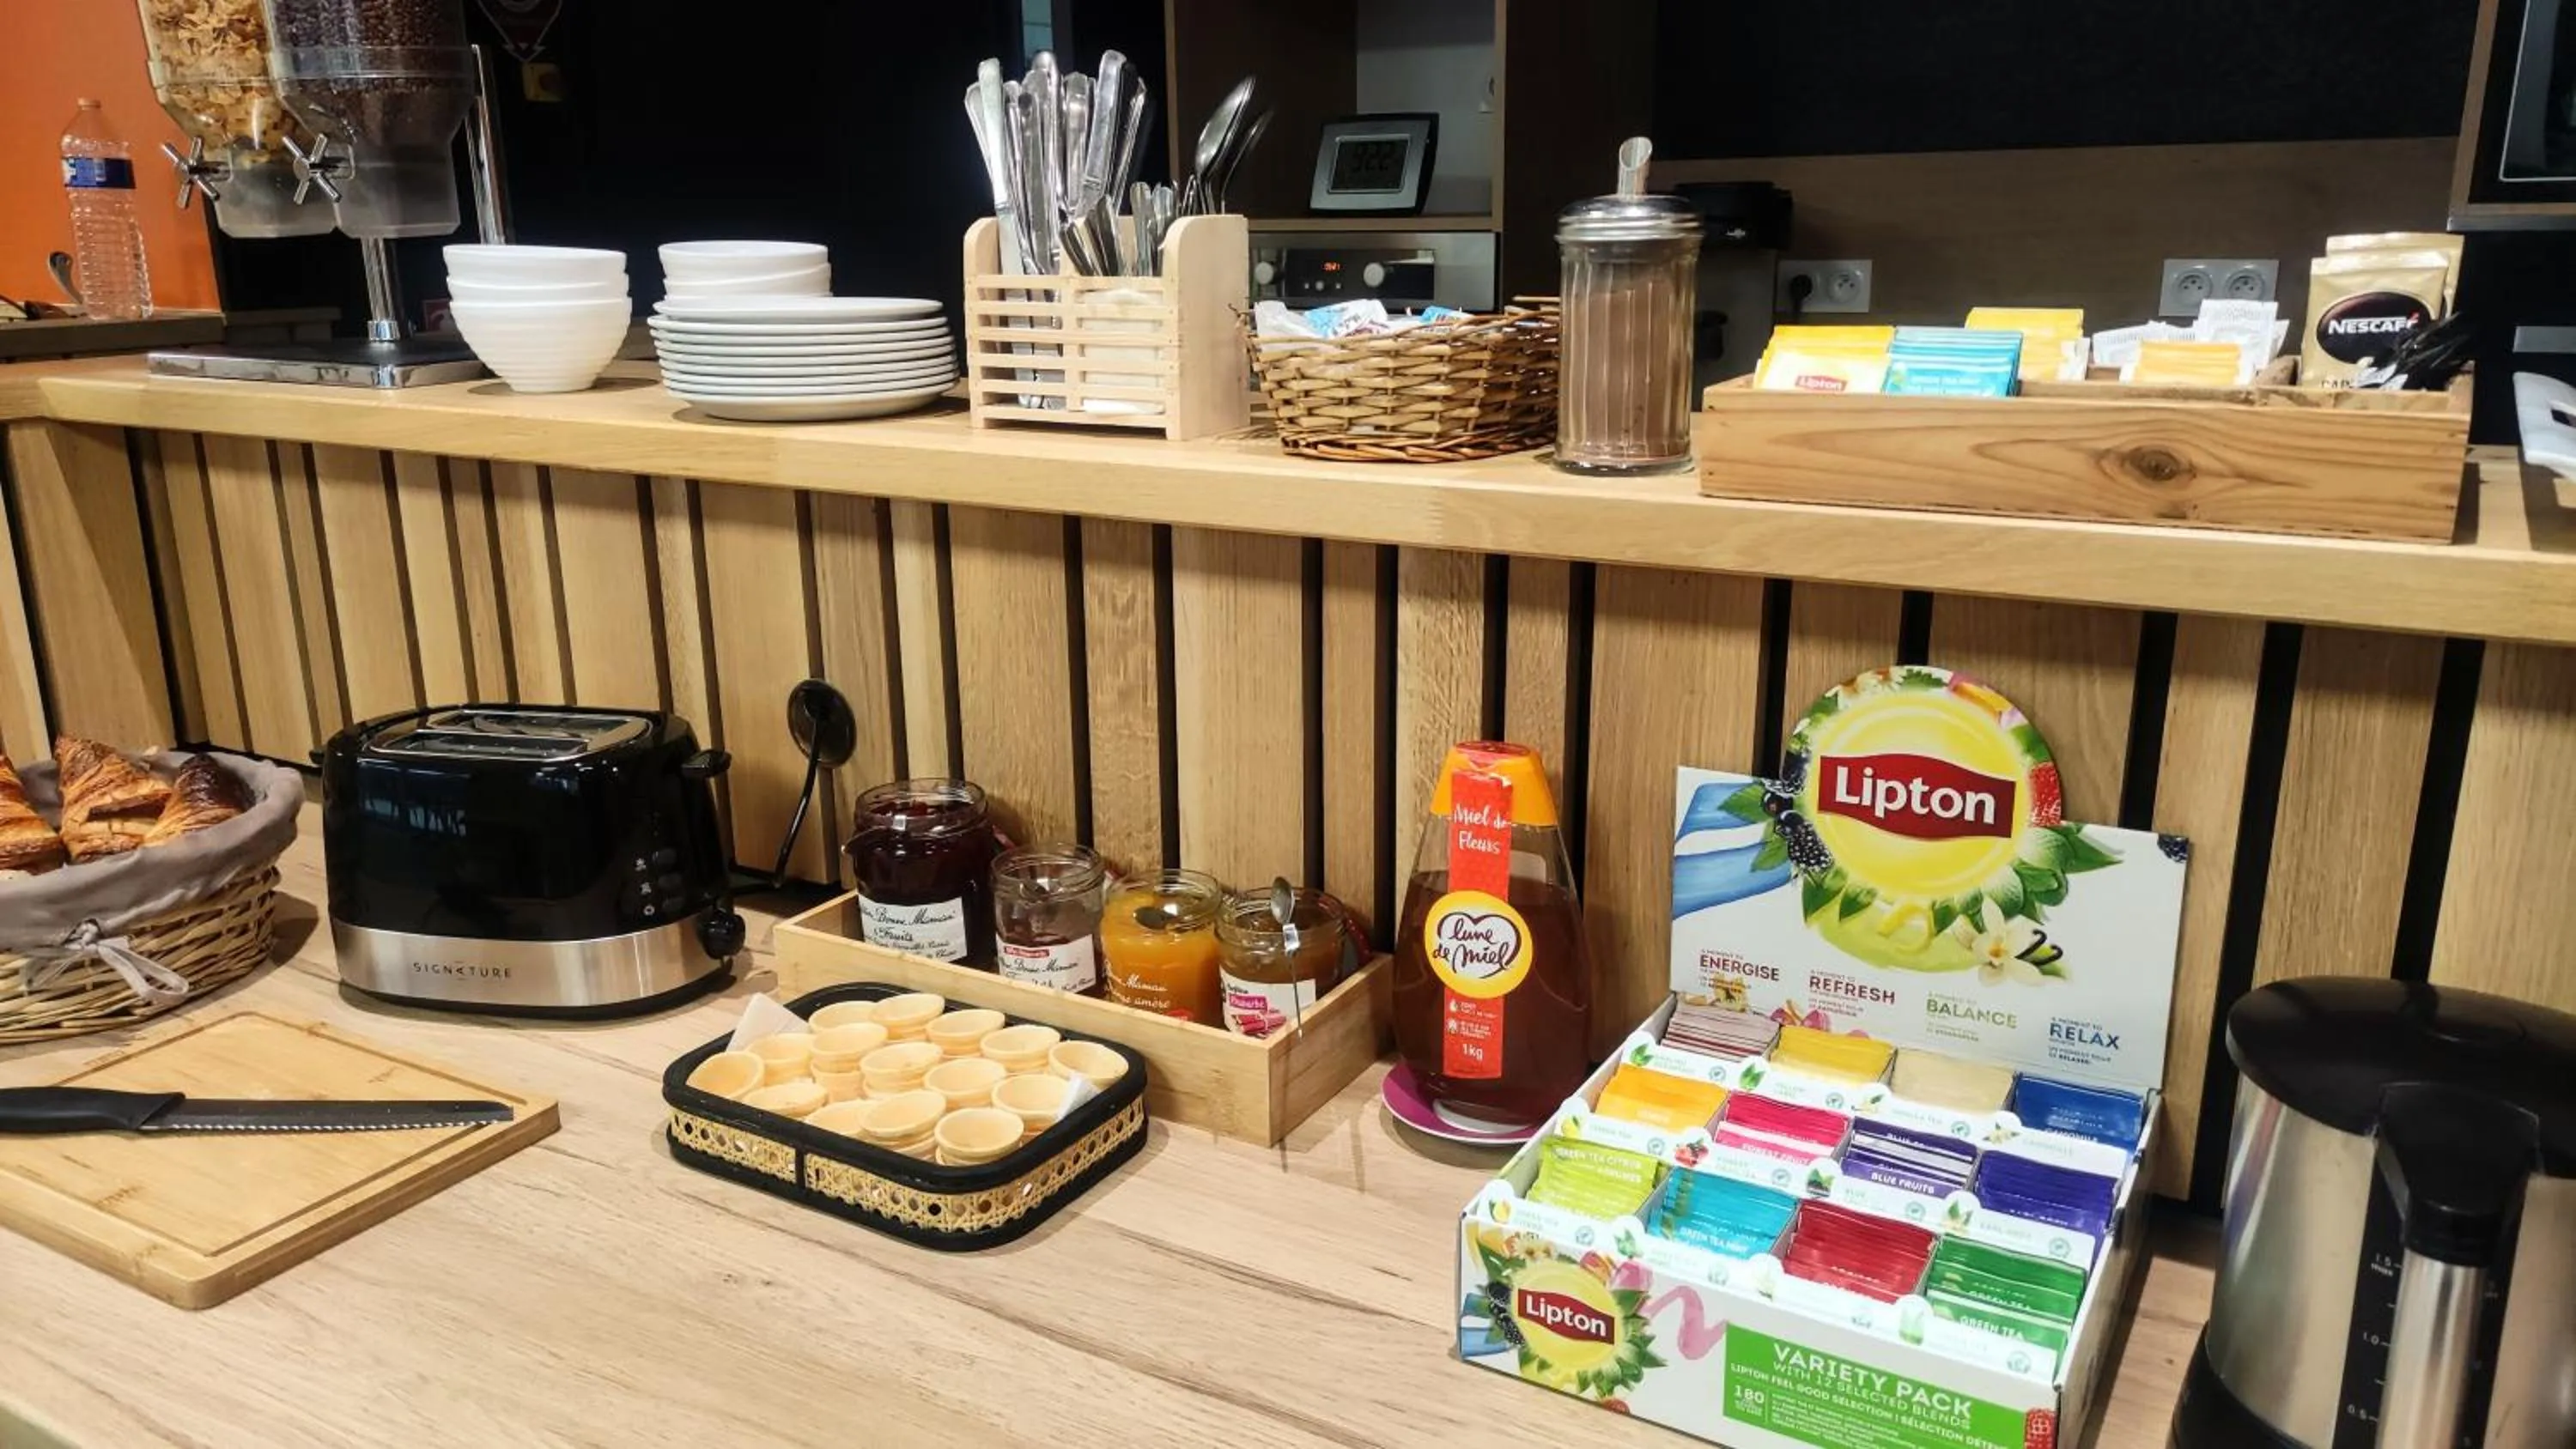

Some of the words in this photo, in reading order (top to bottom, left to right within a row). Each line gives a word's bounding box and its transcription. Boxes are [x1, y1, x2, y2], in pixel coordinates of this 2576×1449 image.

[1798, 377, 1844, 392] Lipton
[1834, 765, 1996, 825] Lipton
[1454, 803, 1490, 827] Miel
[1459, 830, 1502, 855] Fleurs
[1432, 943, 1451, 963] de
[1700, 954, 1780, 981] ENERGISE
[1809, 975, 1896, 1005] REFRESH
[1926, 998, 2016, 1029] BALANCE
[2050, 1022, 2120, 1050] RELAX
[1871, 1172, 1898, 1185] BLUE
[1899, 1179, 1935, 1195] FRUITS
[1525, 1294, 1607, 1337] Lipton
[1959, 1315, 2000, 1334] GREEN
[2002, 1325, 2026, 1340] TEA
[1730, 1362, 1769, 1381] LIPTON
[1771, 1374, 1795, 1389] FEEL
[1796, 1383, 1830, 1401] GOOD
[1735, 1385, 1765, 1404] 180
[1773, 1343, 1887, 1391] VARIETY
[1896, 1379, 1971, 1419] PACK
[1773, 1361, 1811, 1381] WITH
[1816, 1374, 1833, 1389] 12
[1836, 1381, 1908, 1411] SELECTED
[1912, 1404, 1971, 1430] BLENDS
